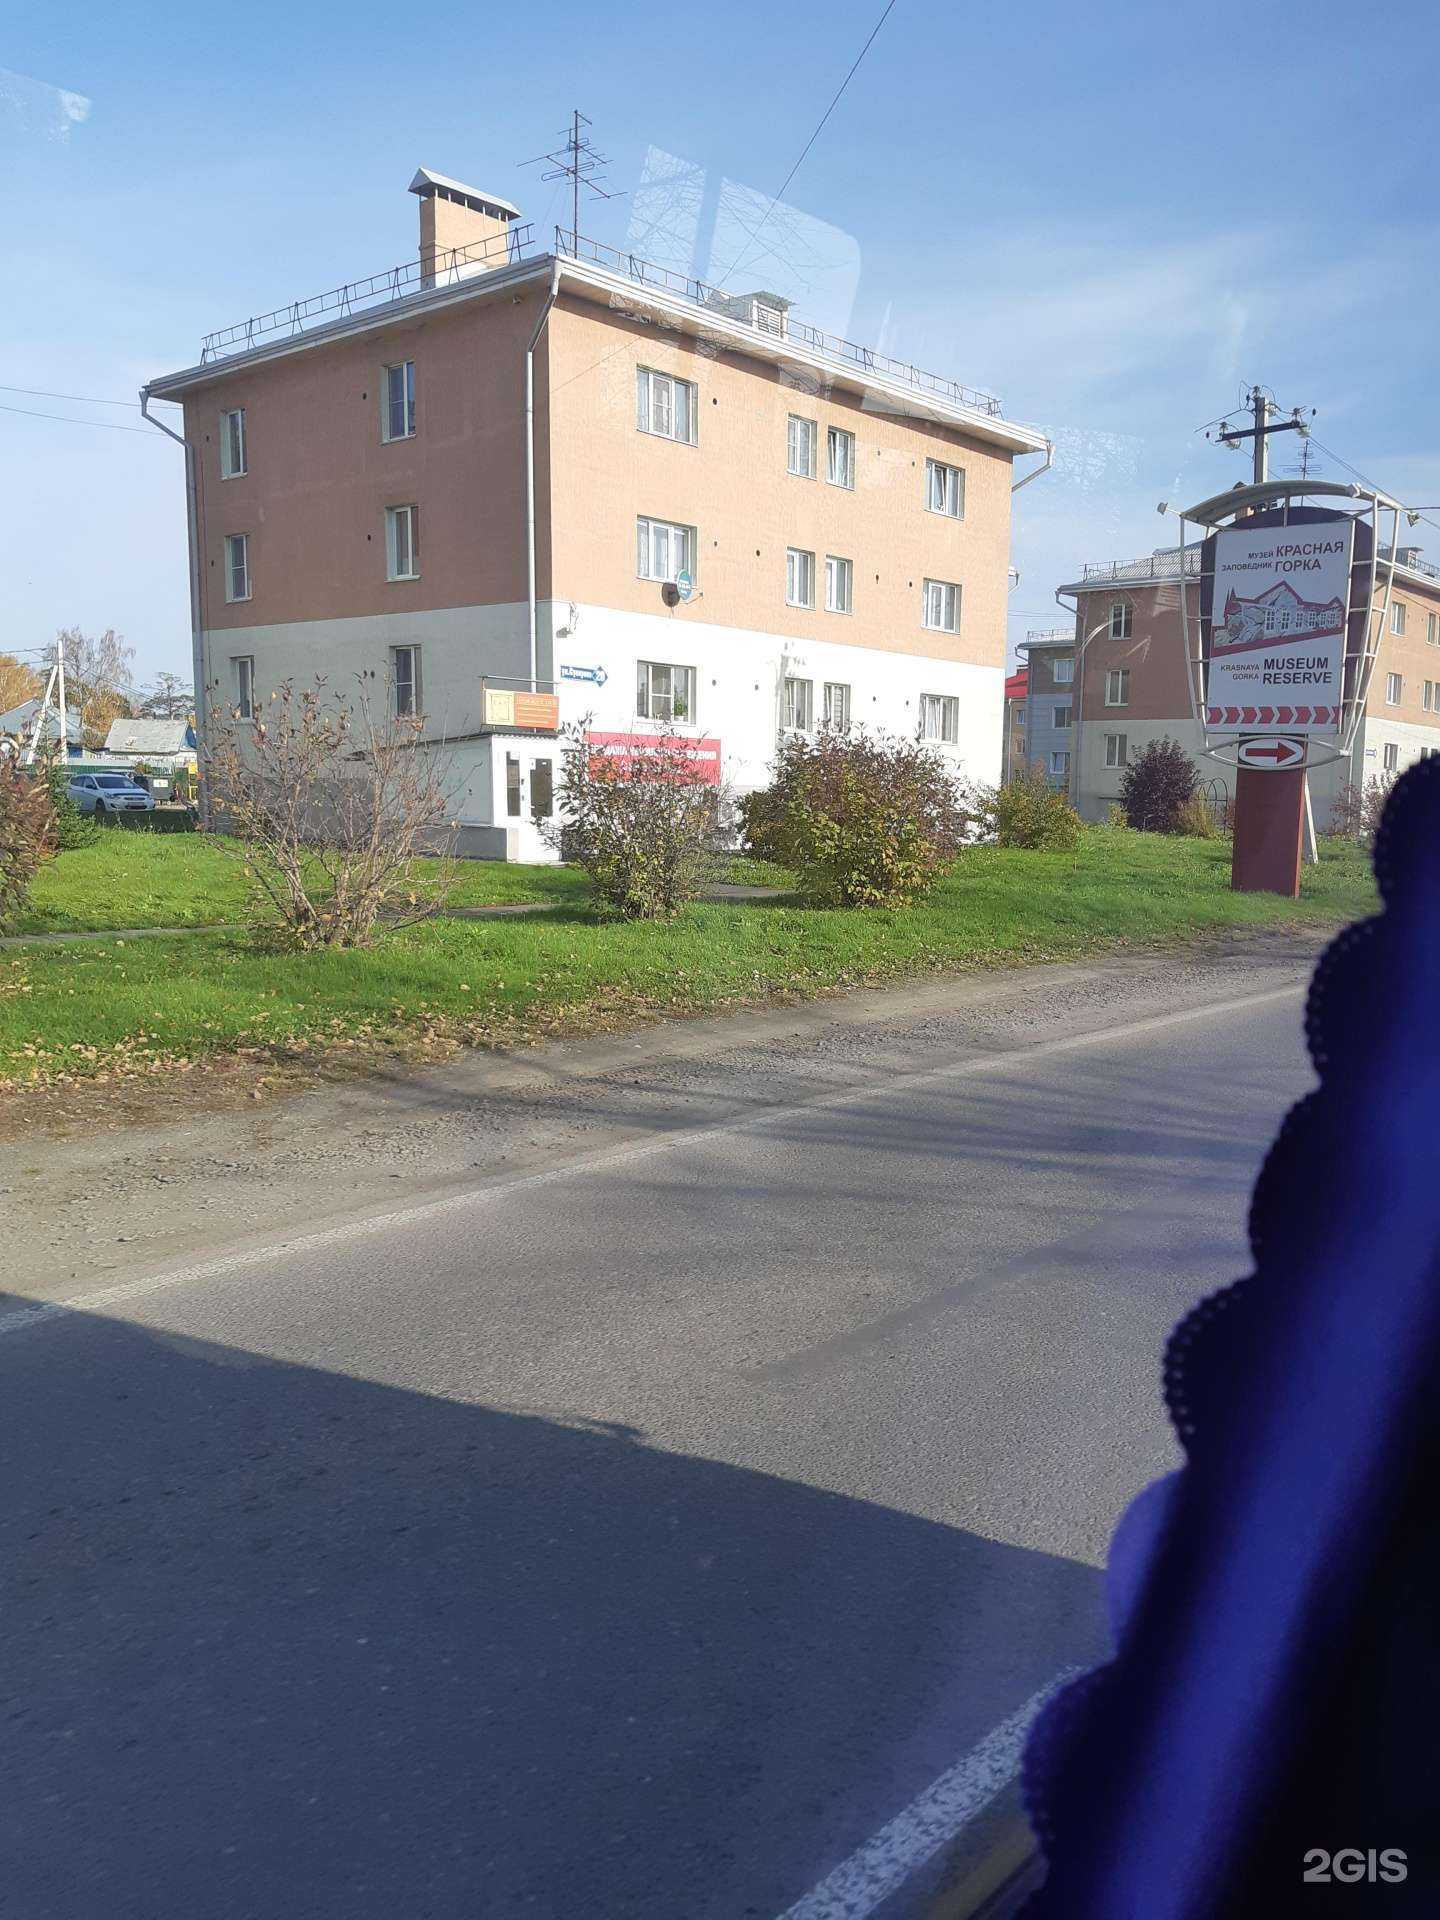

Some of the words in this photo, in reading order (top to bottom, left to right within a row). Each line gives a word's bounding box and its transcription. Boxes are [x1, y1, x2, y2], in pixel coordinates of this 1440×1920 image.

[1247, 550, 1274, 560] МУЗЕЙ
[1276, 541, 1344, 558] КРАСНАЯ
[1221, 561, 1273, 572] ЗАПОВЕДНИК
[1275, 558, 1322, 573] ГОРКА
[1220, 663, 1260, 672] KRASNAYA
[1263, 656, 1329, 670] MUSEUM
[1232, 672, 1260, 681] GORKA
[1262, 671, 1333, 685] RESERVE
